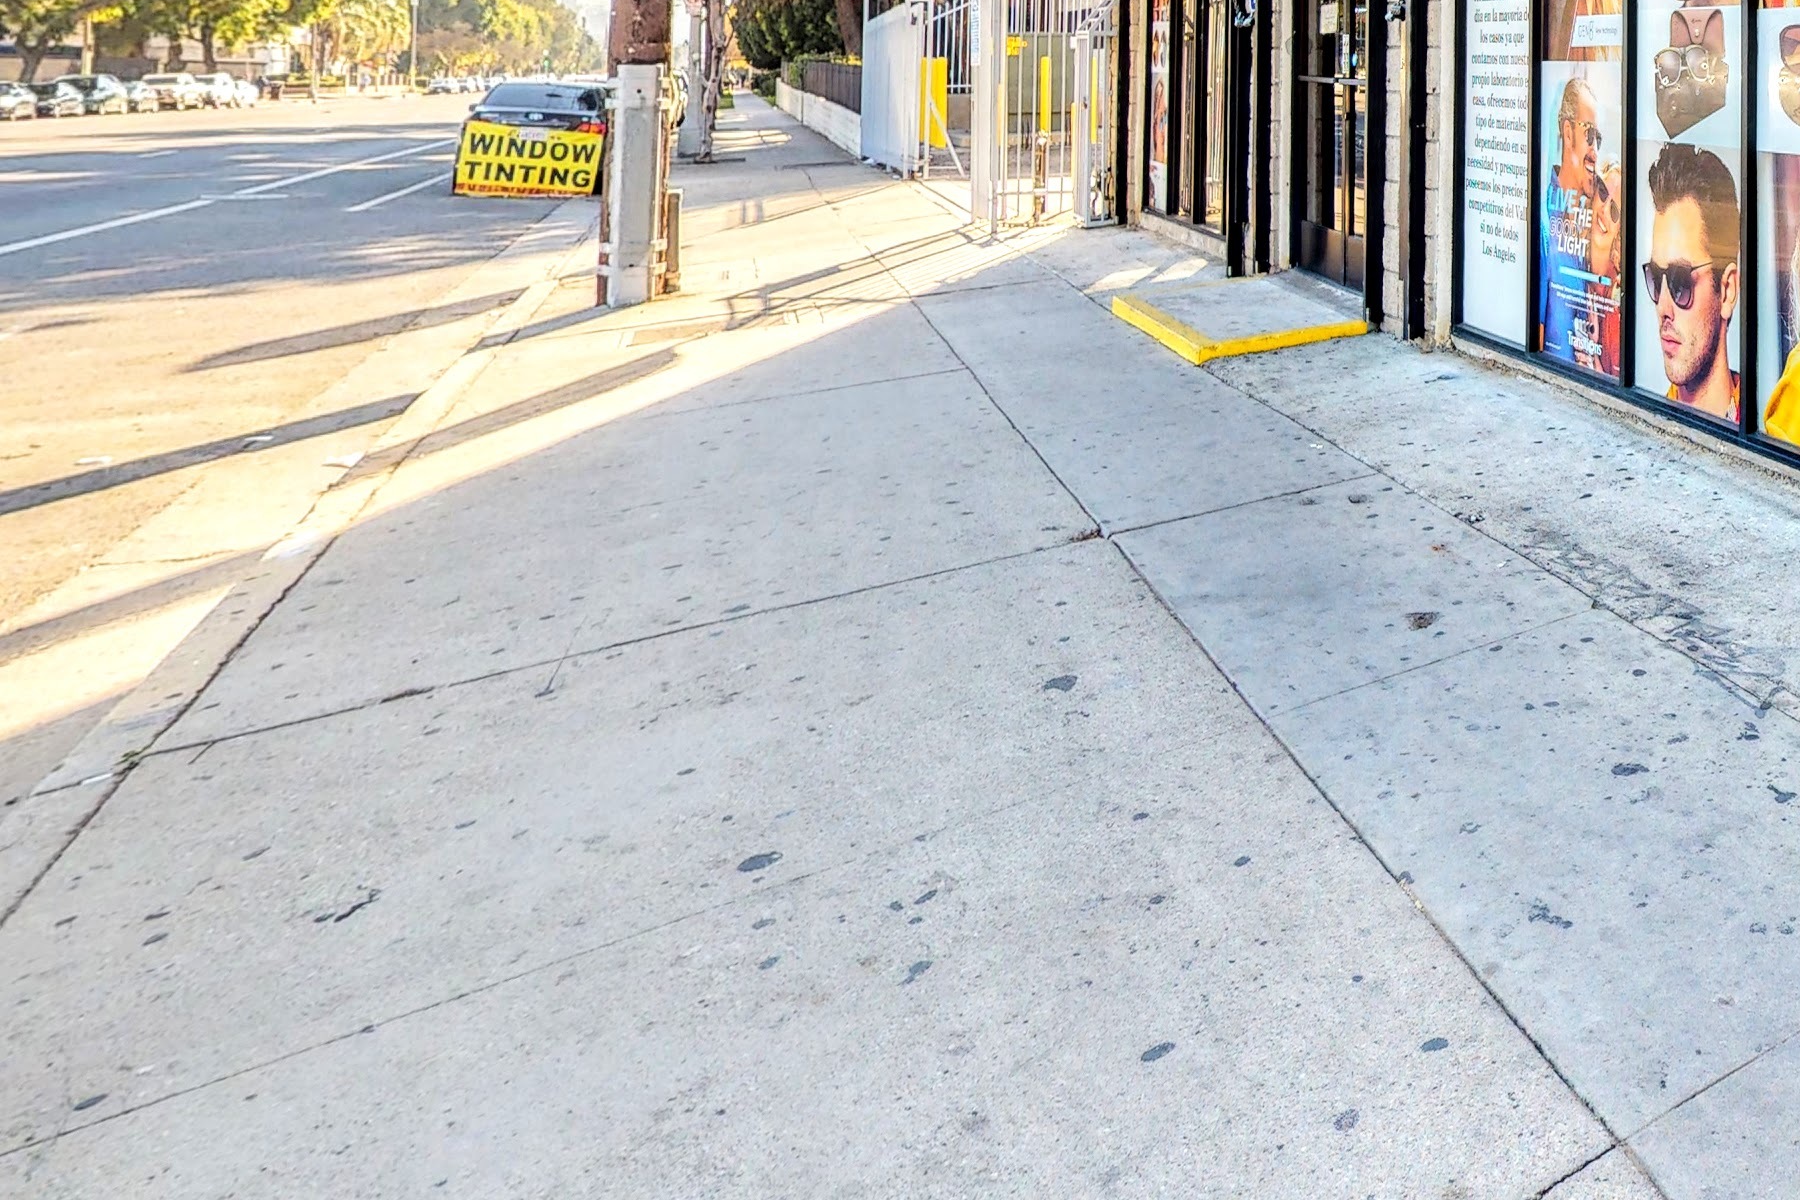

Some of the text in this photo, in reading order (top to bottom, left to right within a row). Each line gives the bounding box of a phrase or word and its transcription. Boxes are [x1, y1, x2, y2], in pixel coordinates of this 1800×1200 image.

[1484, 12, 1491, 22] en
[1492, 8, 1497, 22] la
[1480, 29, 1524, 47] los casos ya que
[1472, 52, 1498, 65] contamos
[1499, 54, 1509, 65] con
[1472, 72, 1490, 88] propio
[1491, 72, 1524, 87] laboratorio
[1487, 93, 1516, 109] ofrecemos
[1476, 113, 1526, 132] tipo de materiales
[470, 132, 597, 164] WINDOW
[1475, 133, 1527, 154] dependiendo en su
[1467, 155, 1493, 171] necesidad
[465, 160, 591, 188] TINTING
[1465, 178, 1491, 192] poseemos
[1492, 178, 1500, 193] los
[1502, 182, 1523, 198] precios
[1469, 199, 1504, 216] competitivos
[1505, 203, 1514, 218] del
[1547, 185, 1578, 214] LIVE
[1549, 216, 1577, 237] GOOD
[1573, 207, 1593, 228] THE
[1480, 219, 1519, 242] si no de todos
[1482, 240, 1516, 263] Los Angeles
[1558, 234, 1590, 257] LIGHT
[1567, 330, 1602, 356] Transitions
